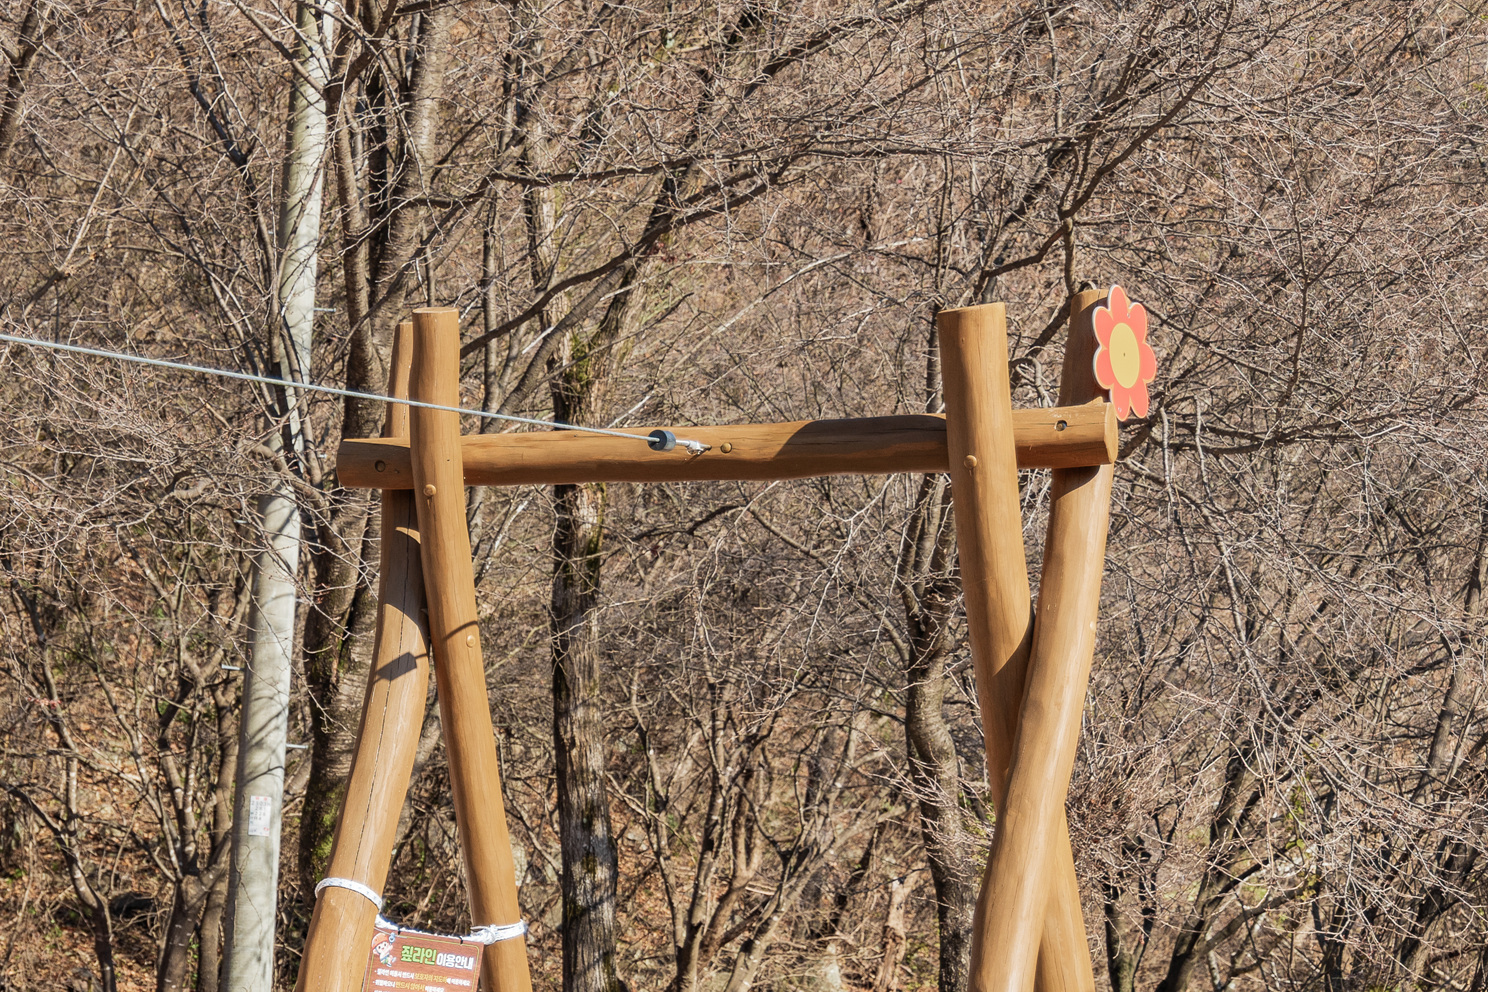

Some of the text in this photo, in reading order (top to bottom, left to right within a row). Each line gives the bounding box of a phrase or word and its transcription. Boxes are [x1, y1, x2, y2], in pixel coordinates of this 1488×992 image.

[401, 946, 474, 970] 짚라인 이용안내
[415, 973, 433, 981] 보호자의
